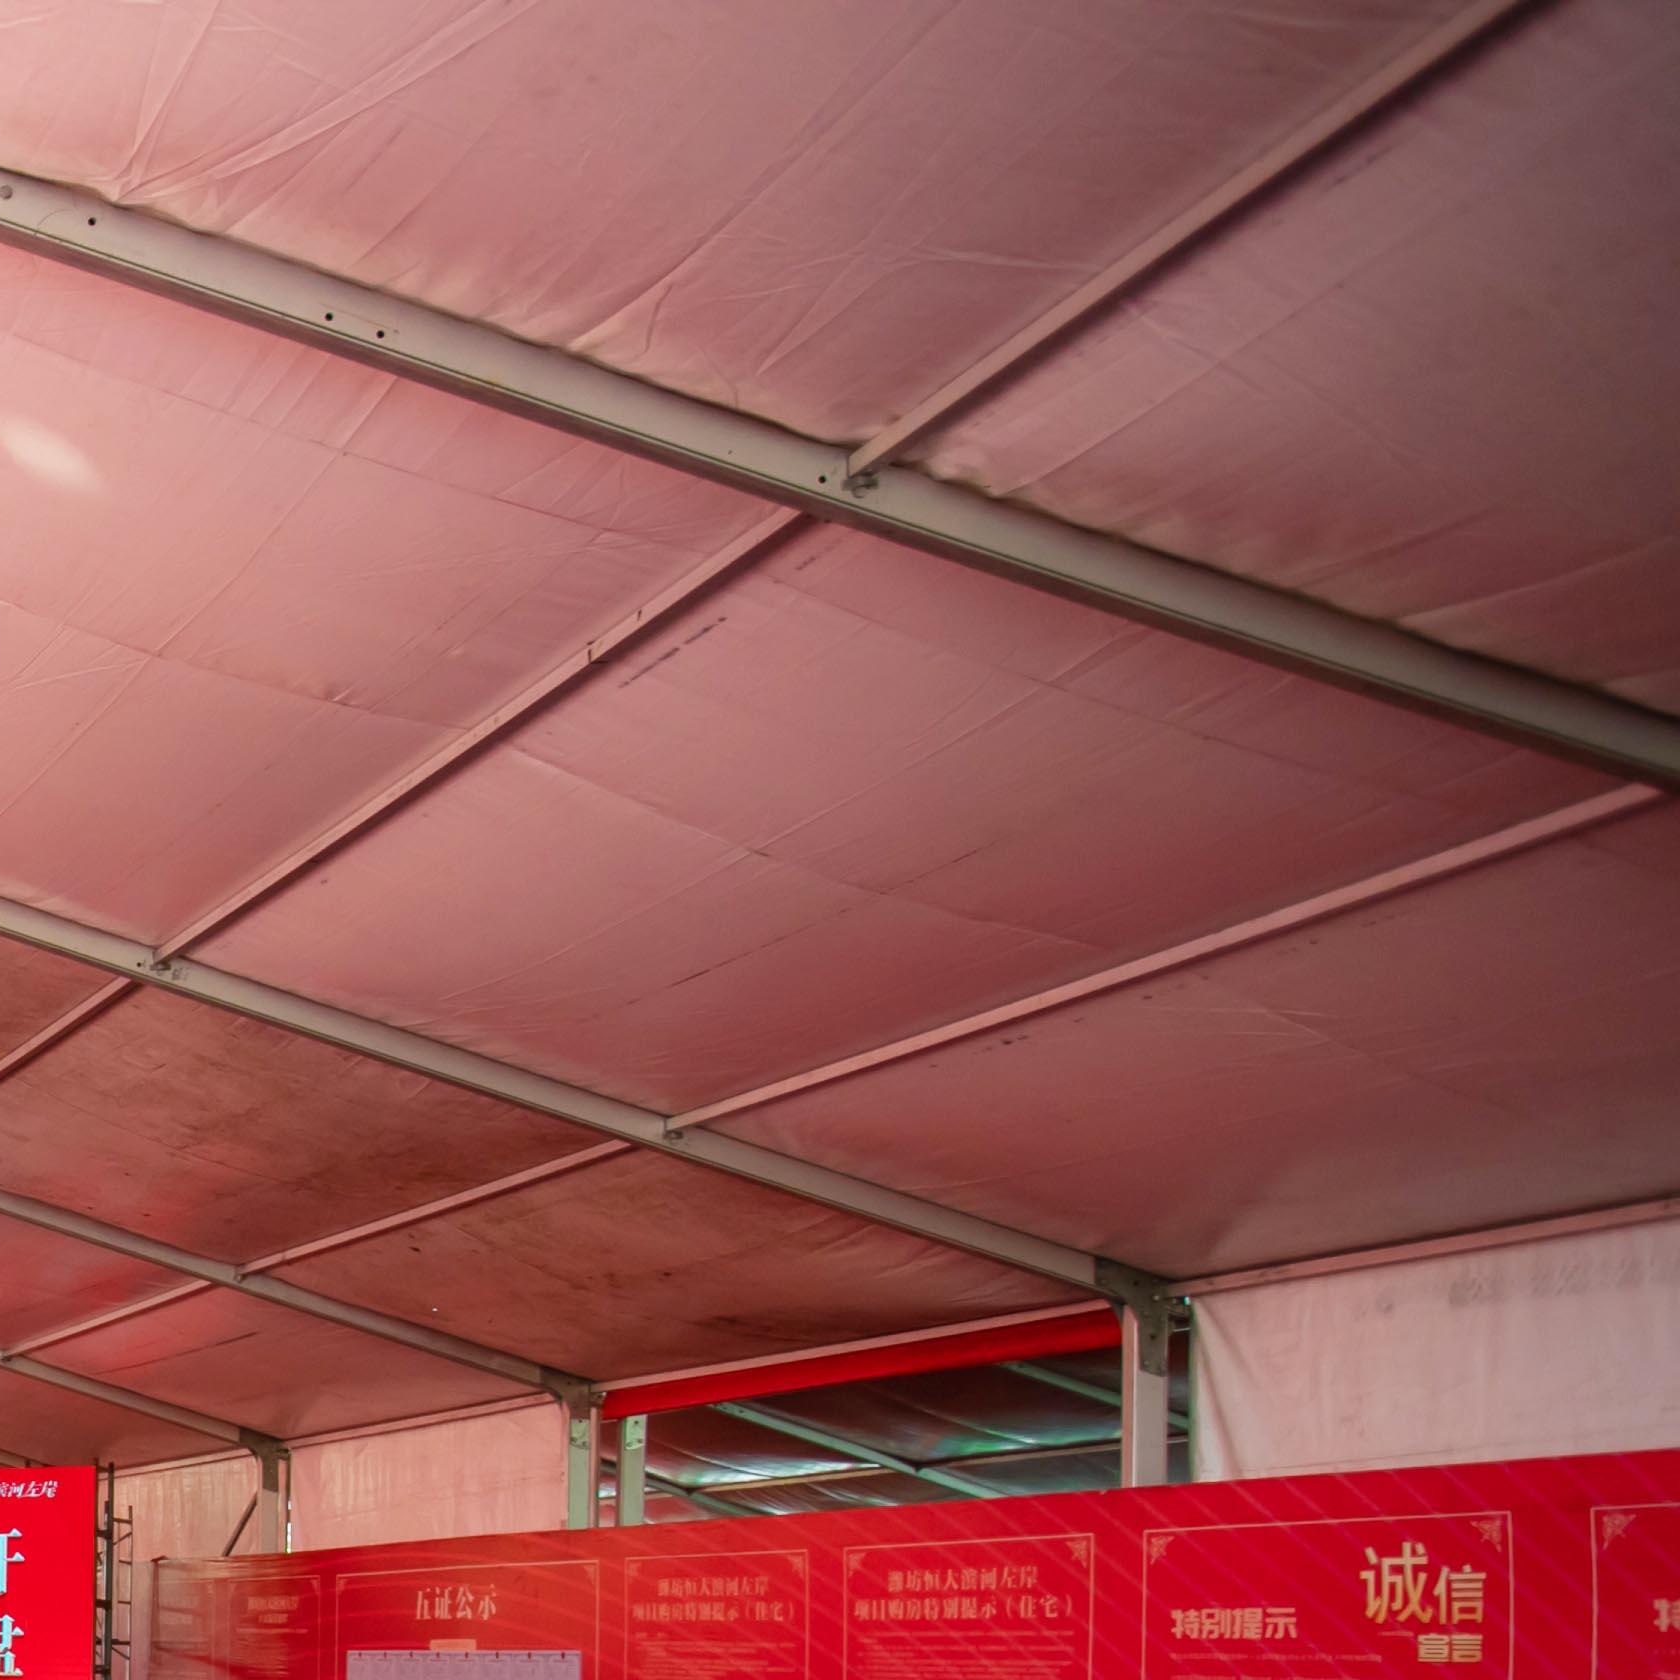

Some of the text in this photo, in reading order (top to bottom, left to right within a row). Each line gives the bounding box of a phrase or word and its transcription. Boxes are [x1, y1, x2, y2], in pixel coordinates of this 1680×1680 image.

[1359, 1541, 1488, 1626] 诚信
[1171, 1606, 1297, 1641] 特别提示
[1417, 1632, 1484, 1664] 宣言
